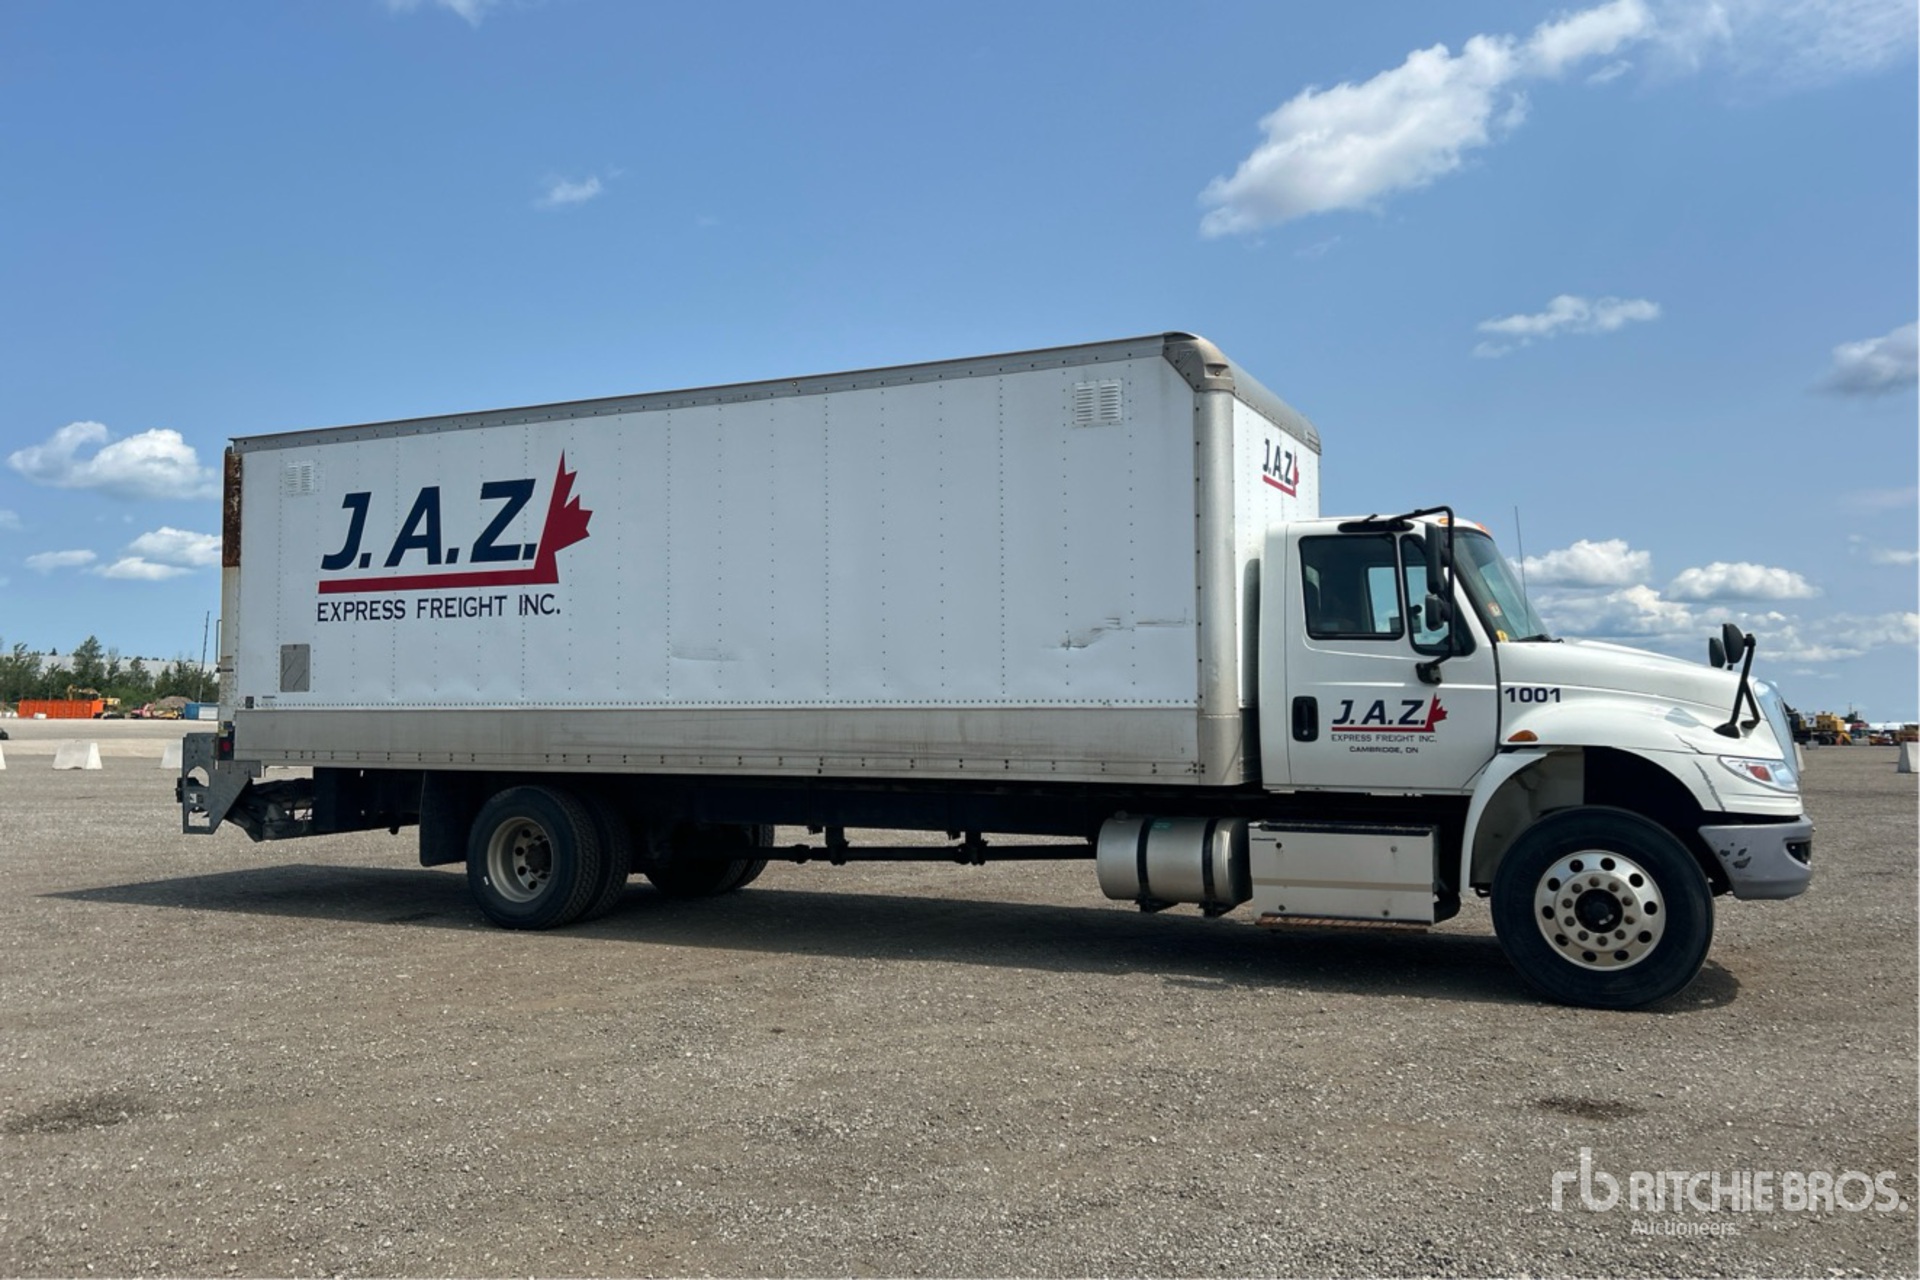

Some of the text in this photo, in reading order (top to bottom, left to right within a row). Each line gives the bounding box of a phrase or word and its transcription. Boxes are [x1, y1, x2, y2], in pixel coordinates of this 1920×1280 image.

[321, 478, 537, 570] J.A.Z.
[316, 592, 562, 622] EXPRESS FREIGHT INC.
[1504, 687, 1561, 703] 1001
[1331, 699, 1427, 725] J.A.Z.
[1331, 734, 1438, 743] EXPRESS FREIGHT INC.
[1349, 746, 1419, 754] CAMBRIDGE, ON
